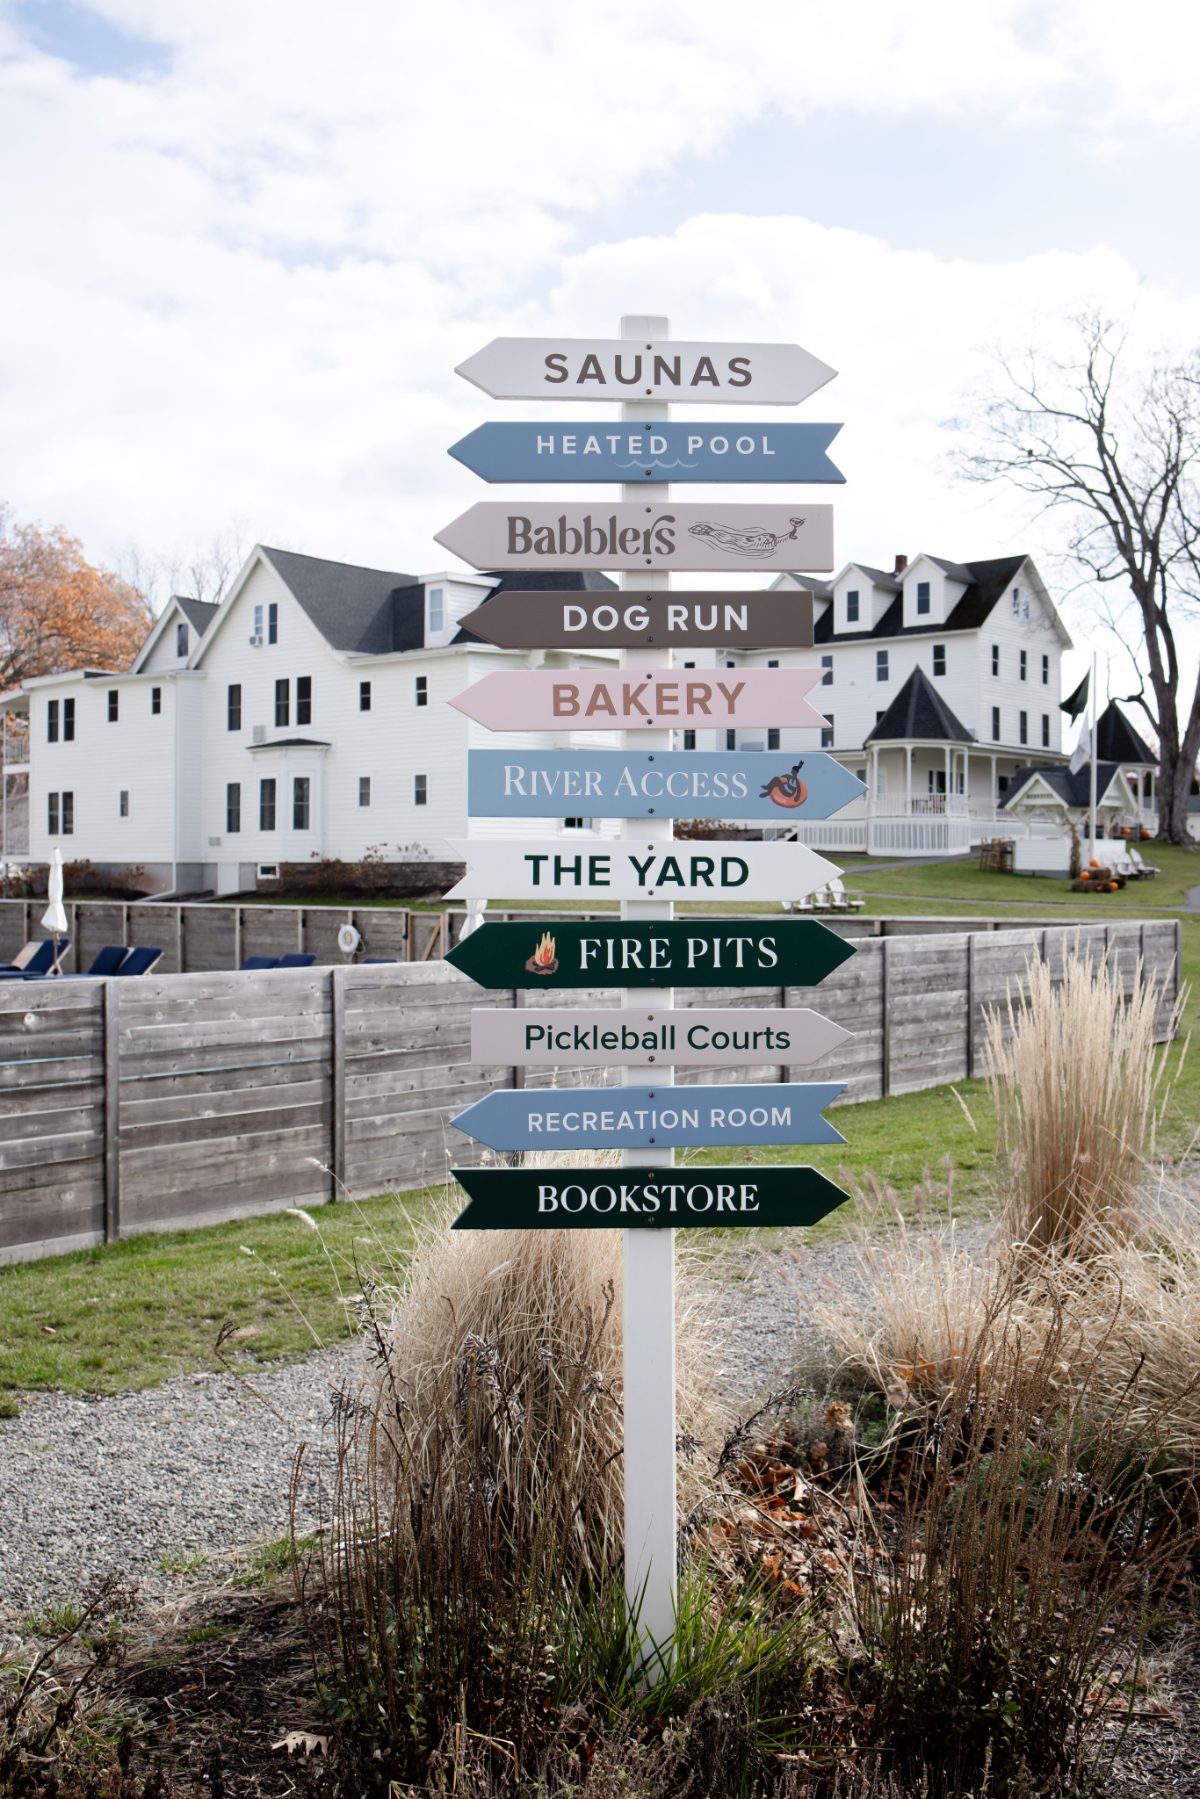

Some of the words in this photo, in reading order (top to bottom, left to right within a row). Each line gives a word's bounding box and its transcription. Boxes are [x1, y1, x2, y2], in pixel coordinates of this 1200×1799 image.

[544, 354, 753, 388] SAUNAS
[537, 435, 668, 455] HEATED
[688, 436, 776, 455] POOL
[563, 605, 650, 632] DOG
[668, 605, 748, 631] RUN
[553, 682, 746, 717] BAKERY
[524, 855, 611, 886] THE
[629, 856, 749, 888] YARD
[579, 938, 671, 969] FIRE
[687, 937, 778, 968] PITS
[525, 1025, 675, 1050] Pickleball
[687, 1025, 790, 1050] Courts
[528, 1109, 699, 1132] RECREATION
[710, 1107, 792, 1128] ROOM
[538, 1185, 760, 1212] BOOKSTORE
